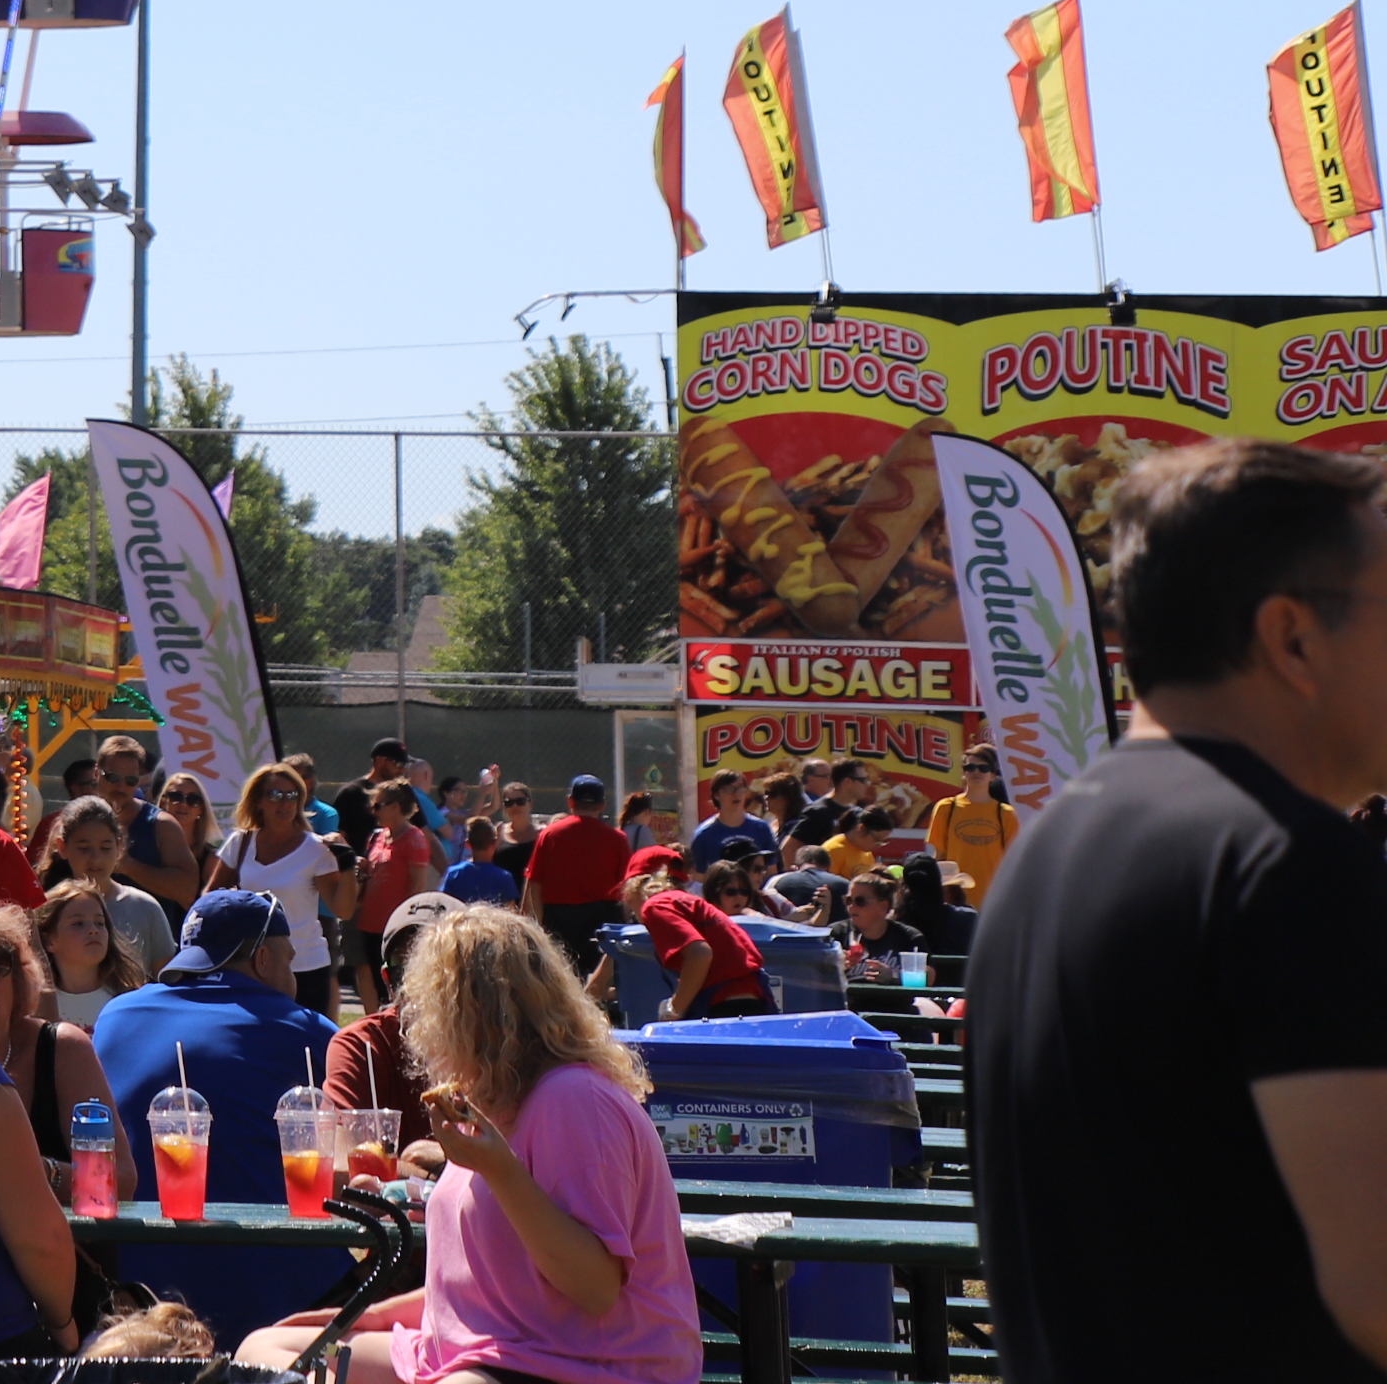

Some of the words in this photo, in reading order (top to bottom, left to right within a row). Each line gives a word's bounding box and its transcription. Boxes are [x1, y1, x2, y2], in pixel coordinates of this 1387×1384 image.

[702, 317, 804, 363] HAND
[808, 317, 929, 363] DIPPED
[683, 348, 811, 412] CORN
[820, 348, 947, 413] DOGS
[983, 325, 1230, 418] POUTINE
[1278, 371, 1368, 424] ON
[117, 452, 204, 675] Bonduelle
[165, 683, 221, 780] WAY
[964, 470, 1047, 704] Bonduelle
[706, 655, 953, 701] SAUSAGE
[753, 644, 824, 656] ITALIAN
[826, 645, 838, 656] &
[843, 646, 901, 658] POLISH
[703, 713, 953, 772] POUTINE
[1000, 712, 1052, 811] WAY
[677, 1103, 752, 1114] CONTAINERS
[755, 1104, 786, 1115] ONLY
